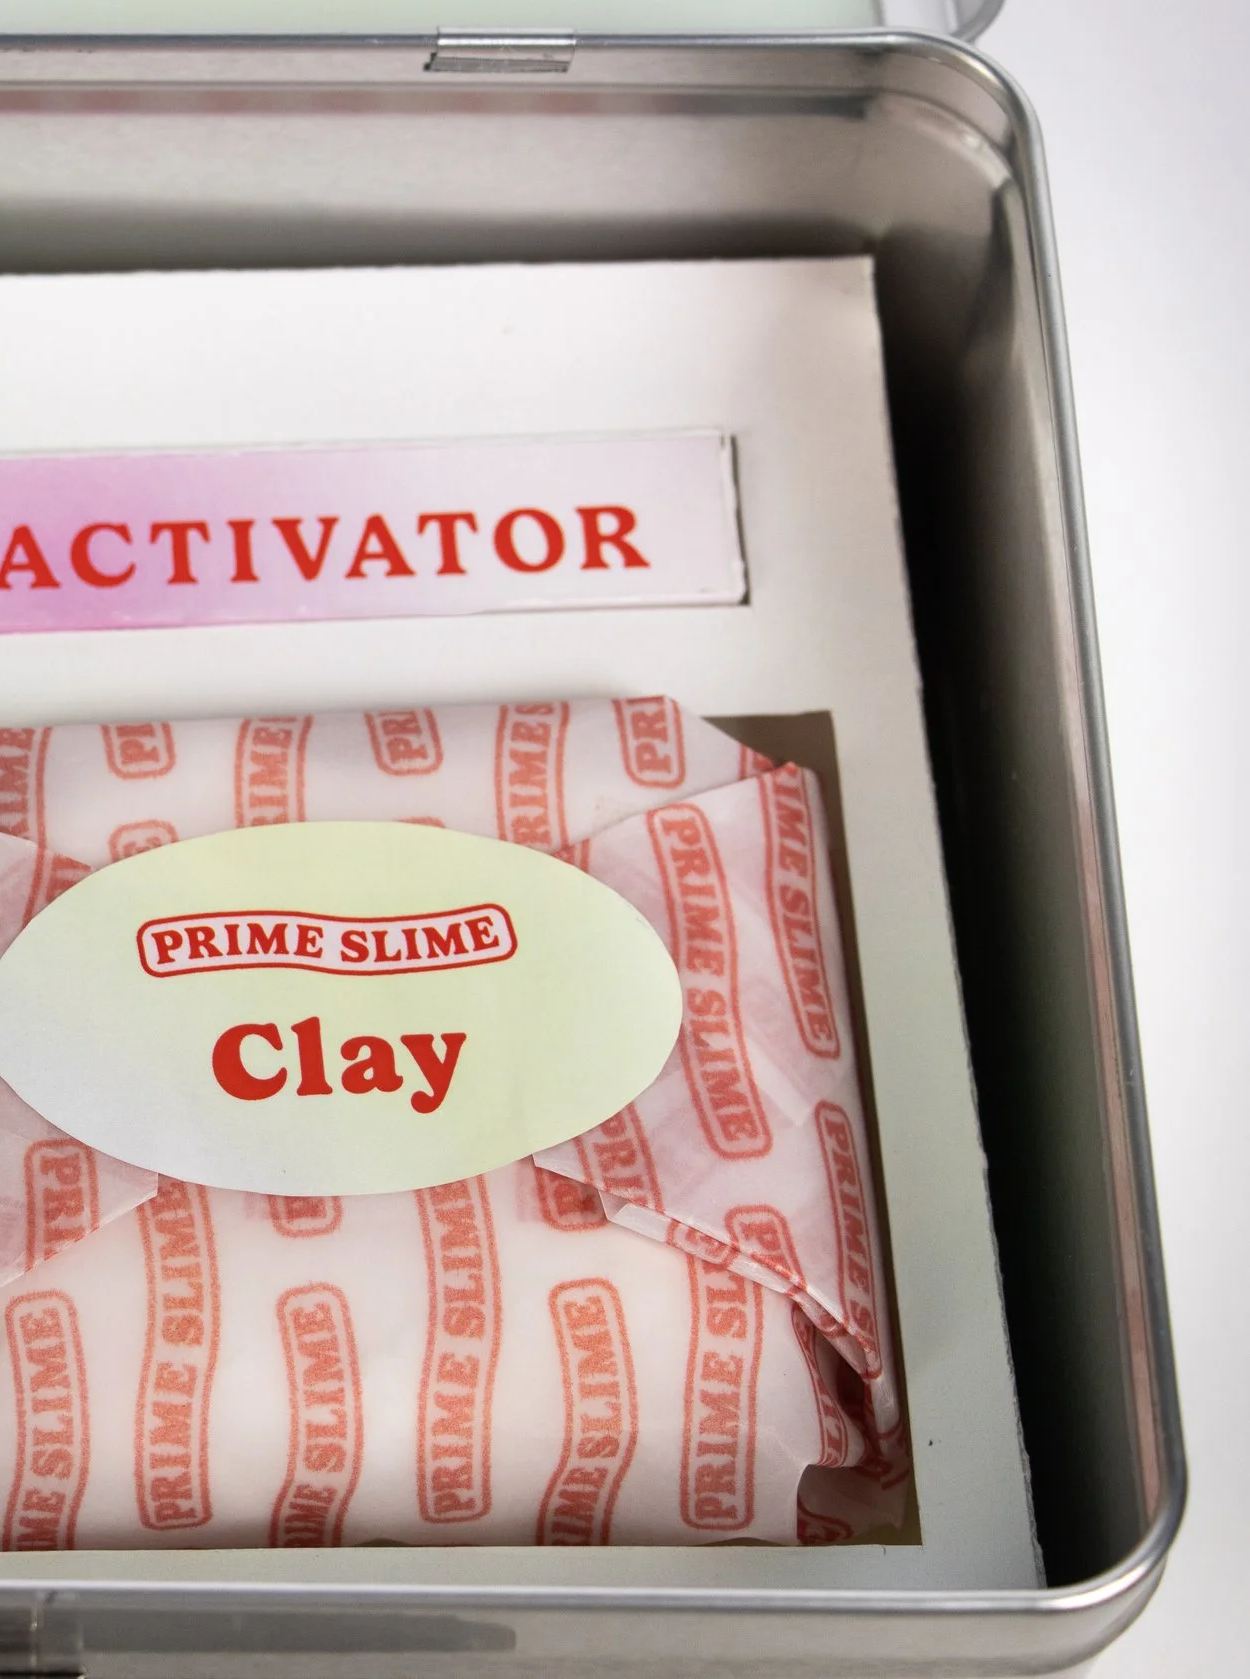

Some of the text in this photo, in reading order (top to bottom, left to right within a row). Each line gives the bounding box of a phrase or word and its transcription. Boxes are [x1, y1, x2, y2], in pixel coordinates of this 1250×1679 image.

[151, 916, 500, 965] PRIME SLIME
[661, 818, 759, 1141] PRIME SLIME
[211, 1016, 467, 1115] Clay
[40, 1153, 86, 1261] PRI
[20, 1307, 75, 1479] SLIME
[150, 1362, 199, 1523] PRIME
[289, 1302, 348, 1472] SLIME
[430, 1351, 480, 1514] PRIME
[563, 1295, 624, 1460] SLIME
[694, 1350, 745, 1520] PRIME
